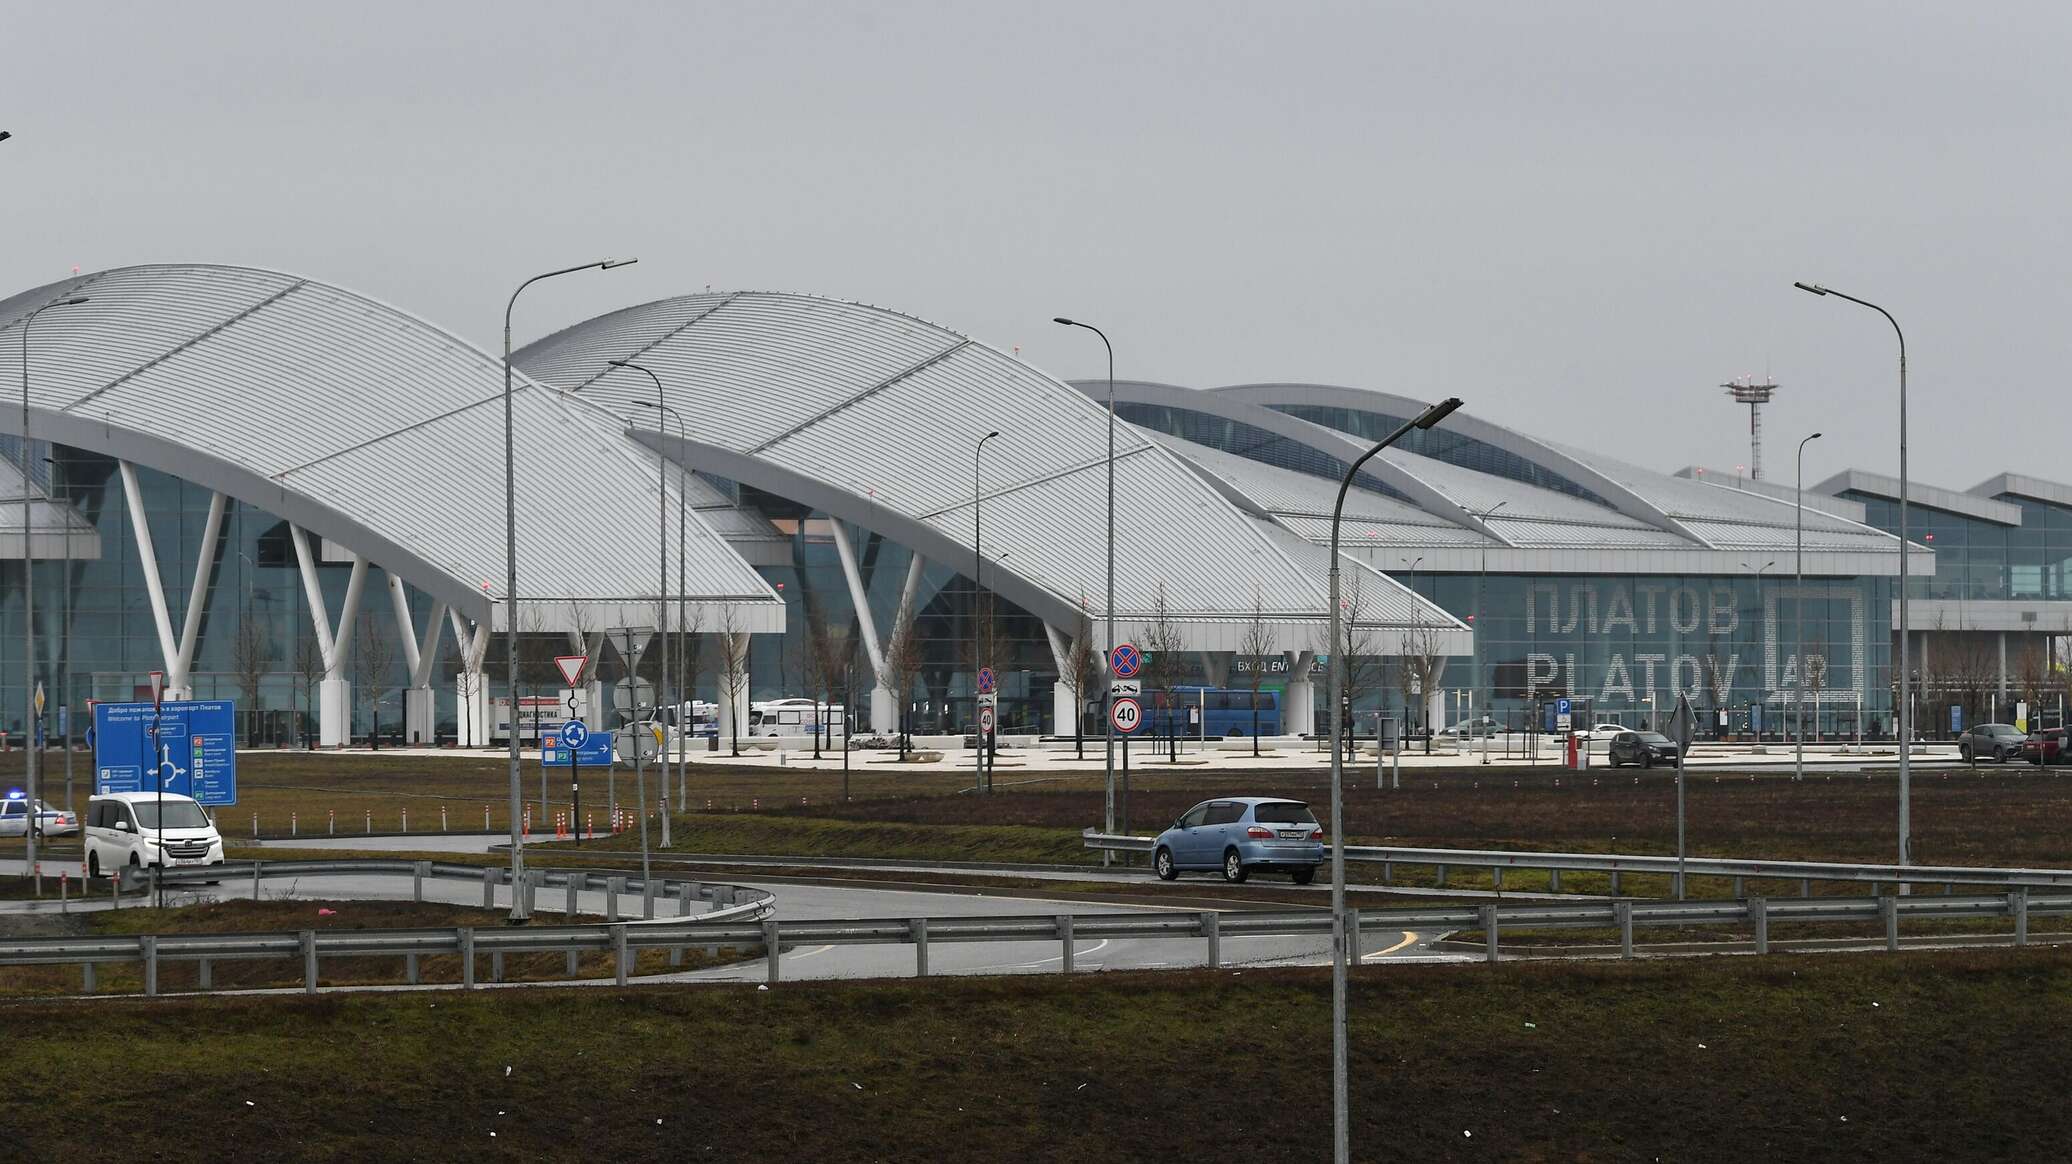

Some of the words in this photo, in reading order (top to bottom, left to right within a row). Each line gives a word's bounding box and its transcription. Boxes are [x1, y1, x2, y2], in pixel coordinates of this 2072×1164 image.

[1526, 584, 1739, 634] ПЛАТОВ
[1237, 661, 1267, 672] ВХОД
[1527, 653, 1739, 702] PLATOV
[108, 706, 128, 714] Добро
[1117, 708, 1136, 722] 40
[982, 716, 991, 726] 40
